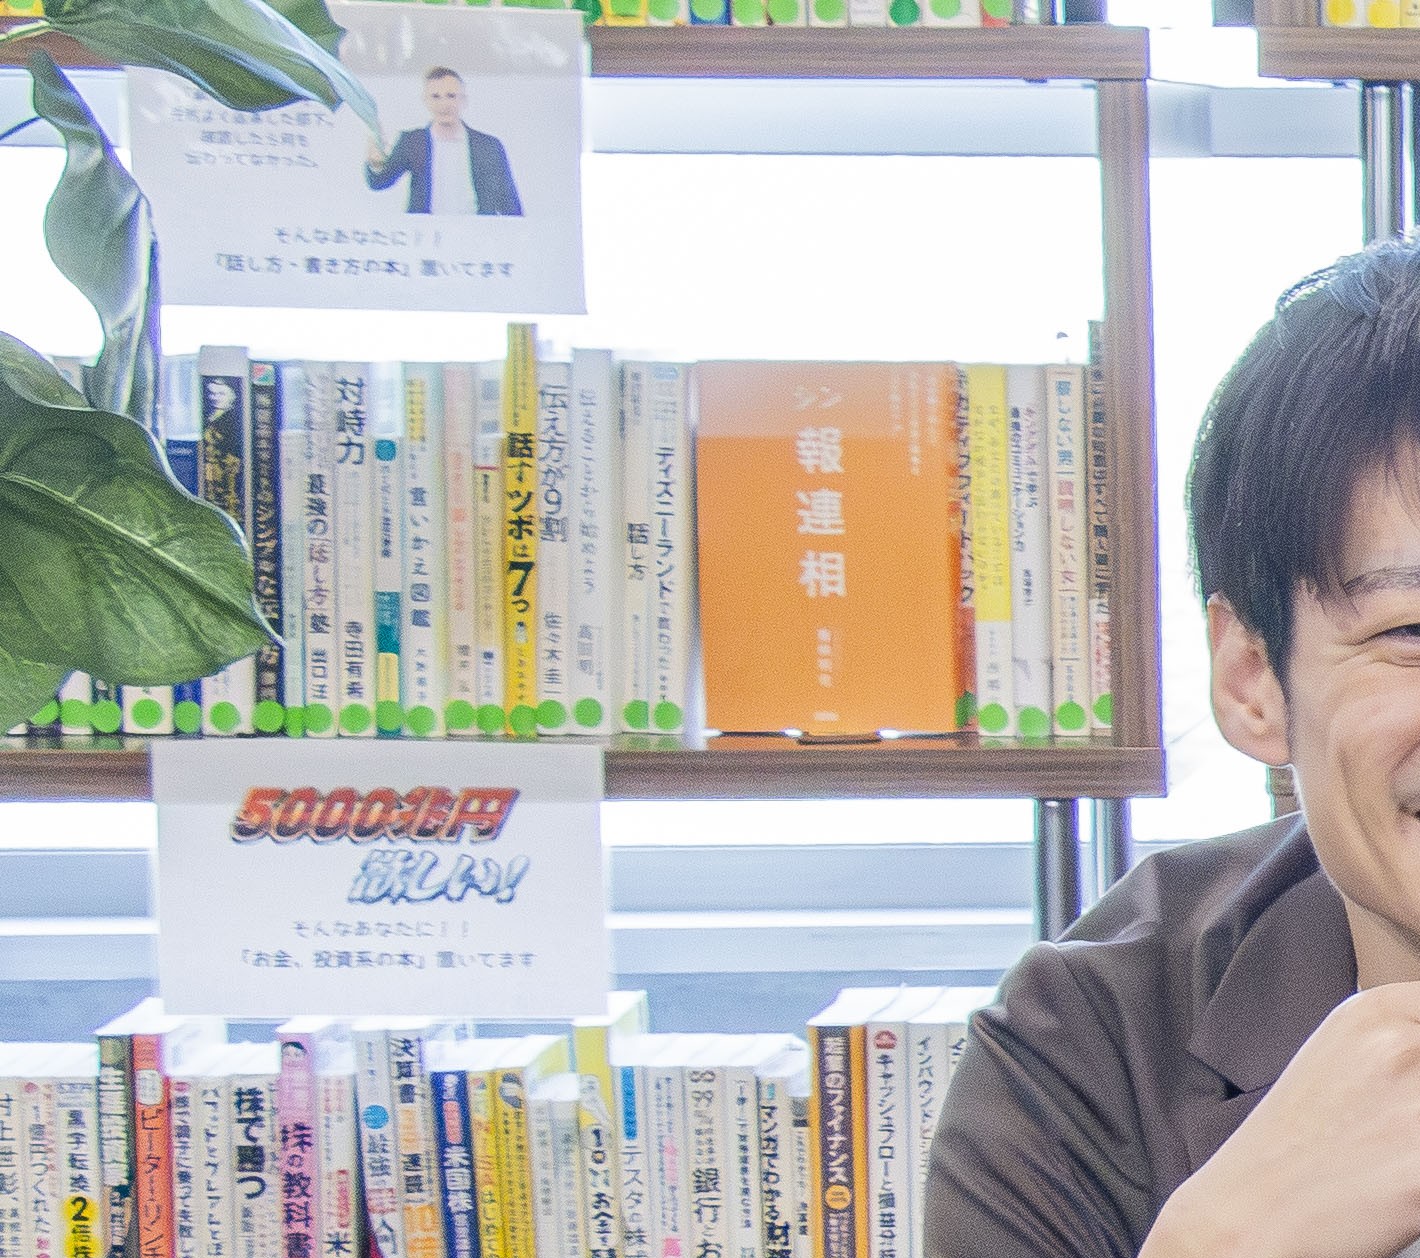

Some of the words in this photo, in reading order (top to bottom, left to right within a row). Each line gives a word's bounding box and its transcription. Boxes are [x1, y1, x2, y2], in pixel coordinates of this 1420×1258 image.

[794, 385, 839, 411] シン
[539, 383, 569, 543] 伝え方が9割
[795, 426, 848, 599] 報連相
[231, 785, 521, 843] 5000兆円
